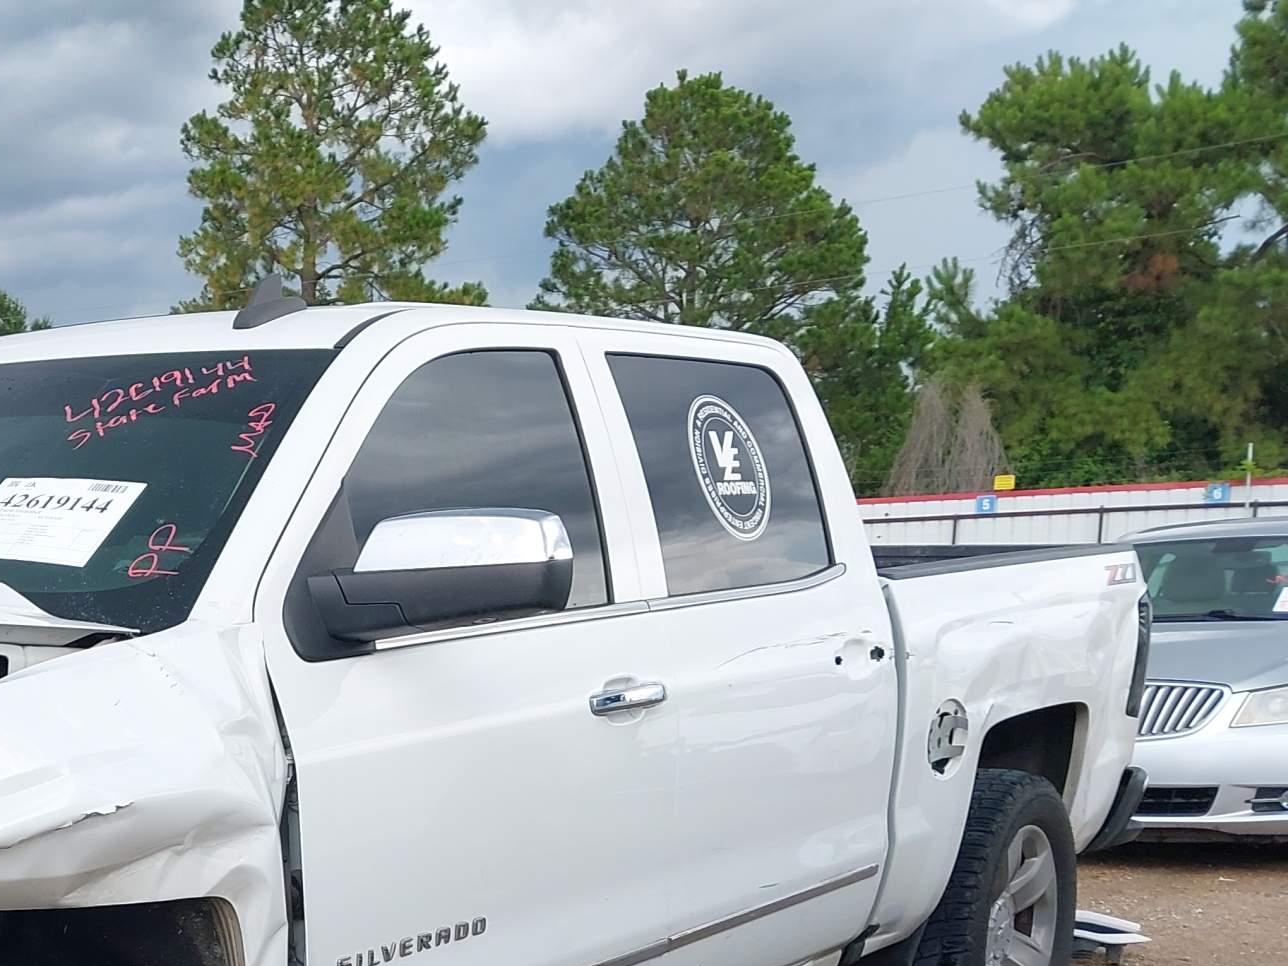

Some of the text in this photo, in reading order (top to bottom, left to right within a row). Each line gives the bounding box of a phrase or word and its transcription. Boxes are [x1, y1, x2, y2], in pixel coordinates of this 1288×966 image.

[173, 372, 258, 407] Farm
[716, 481, 758, 496] ROOFING
[1213, 488, 1223, 500] 6
[0, 493, 114, 514] 42619144
[982, 498, 990, 510] 5
